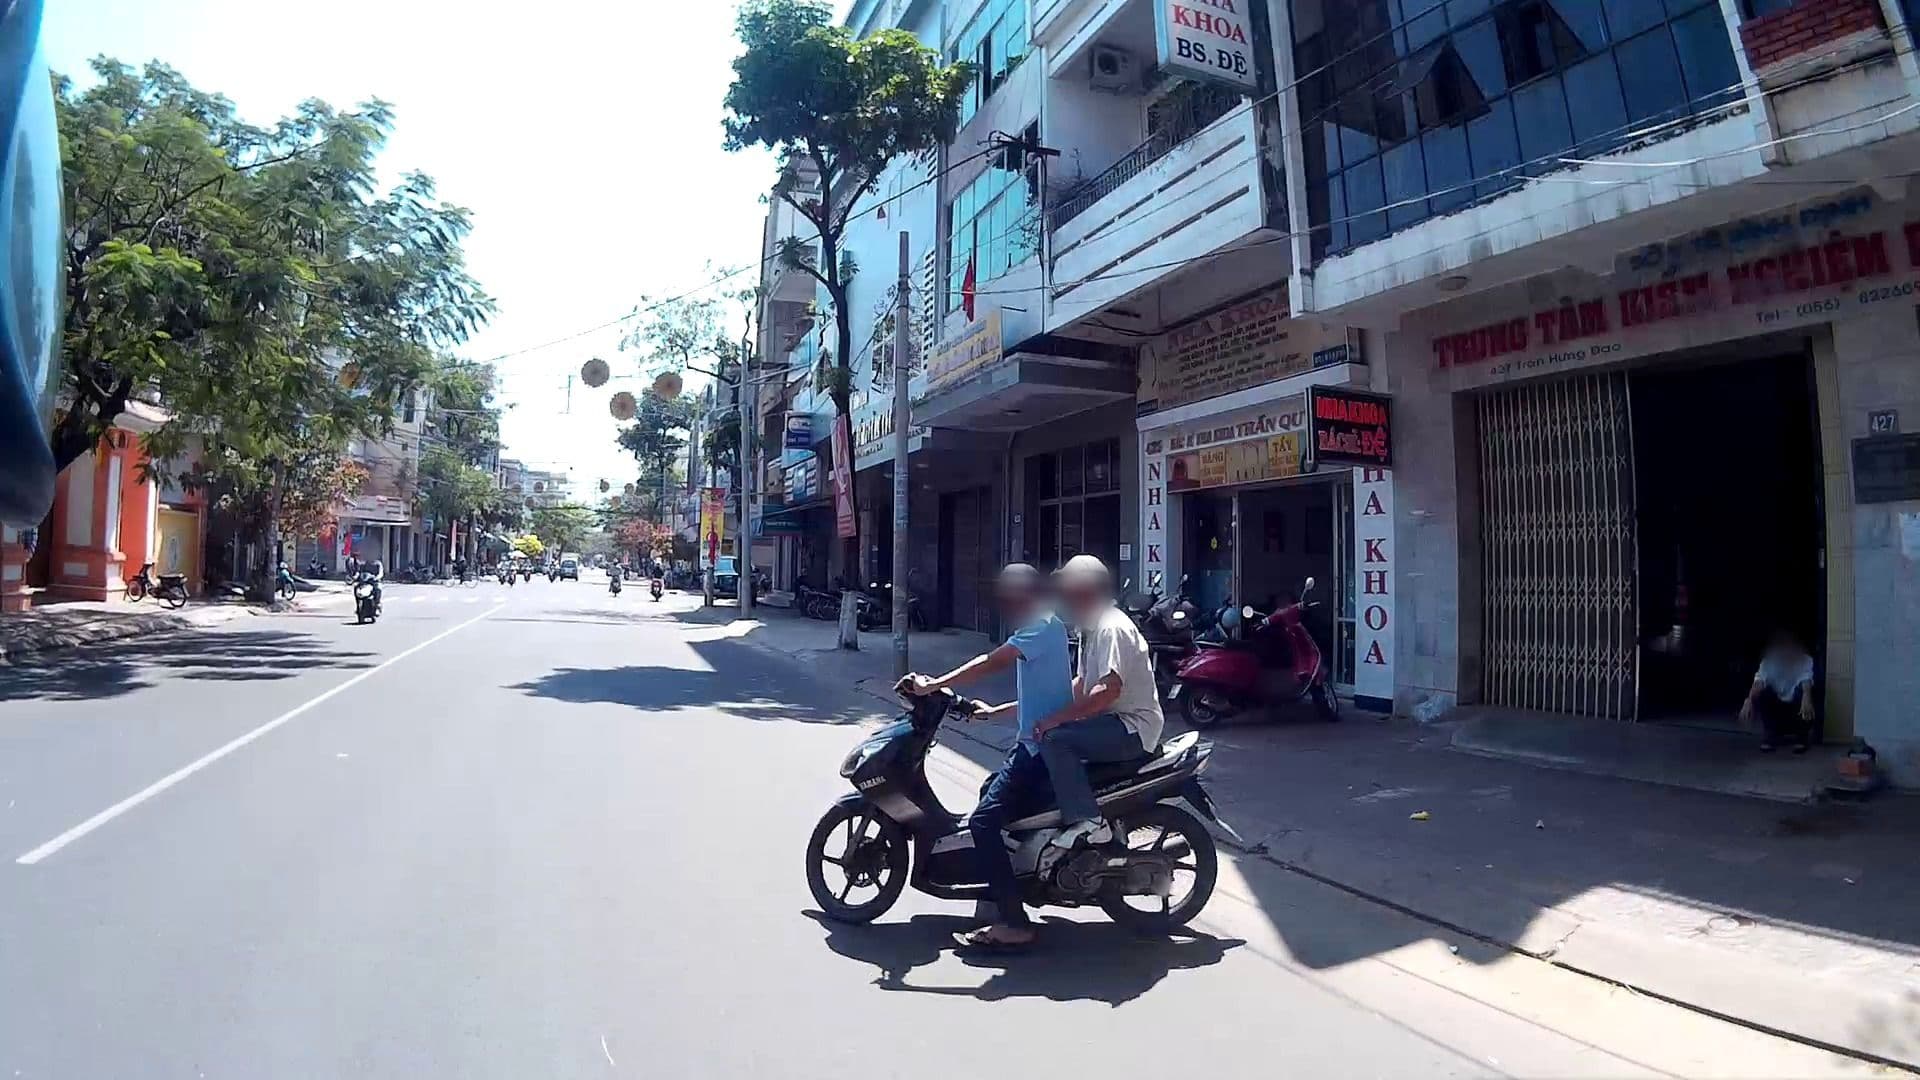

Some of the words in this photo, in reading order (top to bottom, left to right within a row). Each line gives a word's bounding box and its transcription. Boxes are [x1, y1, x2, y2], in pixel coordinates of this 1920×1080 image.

[1170, 4, 1248, 46] KHOA
[1871, 414, 1896, 433] 427
[1362, 538, 1389, 665] KHOA
